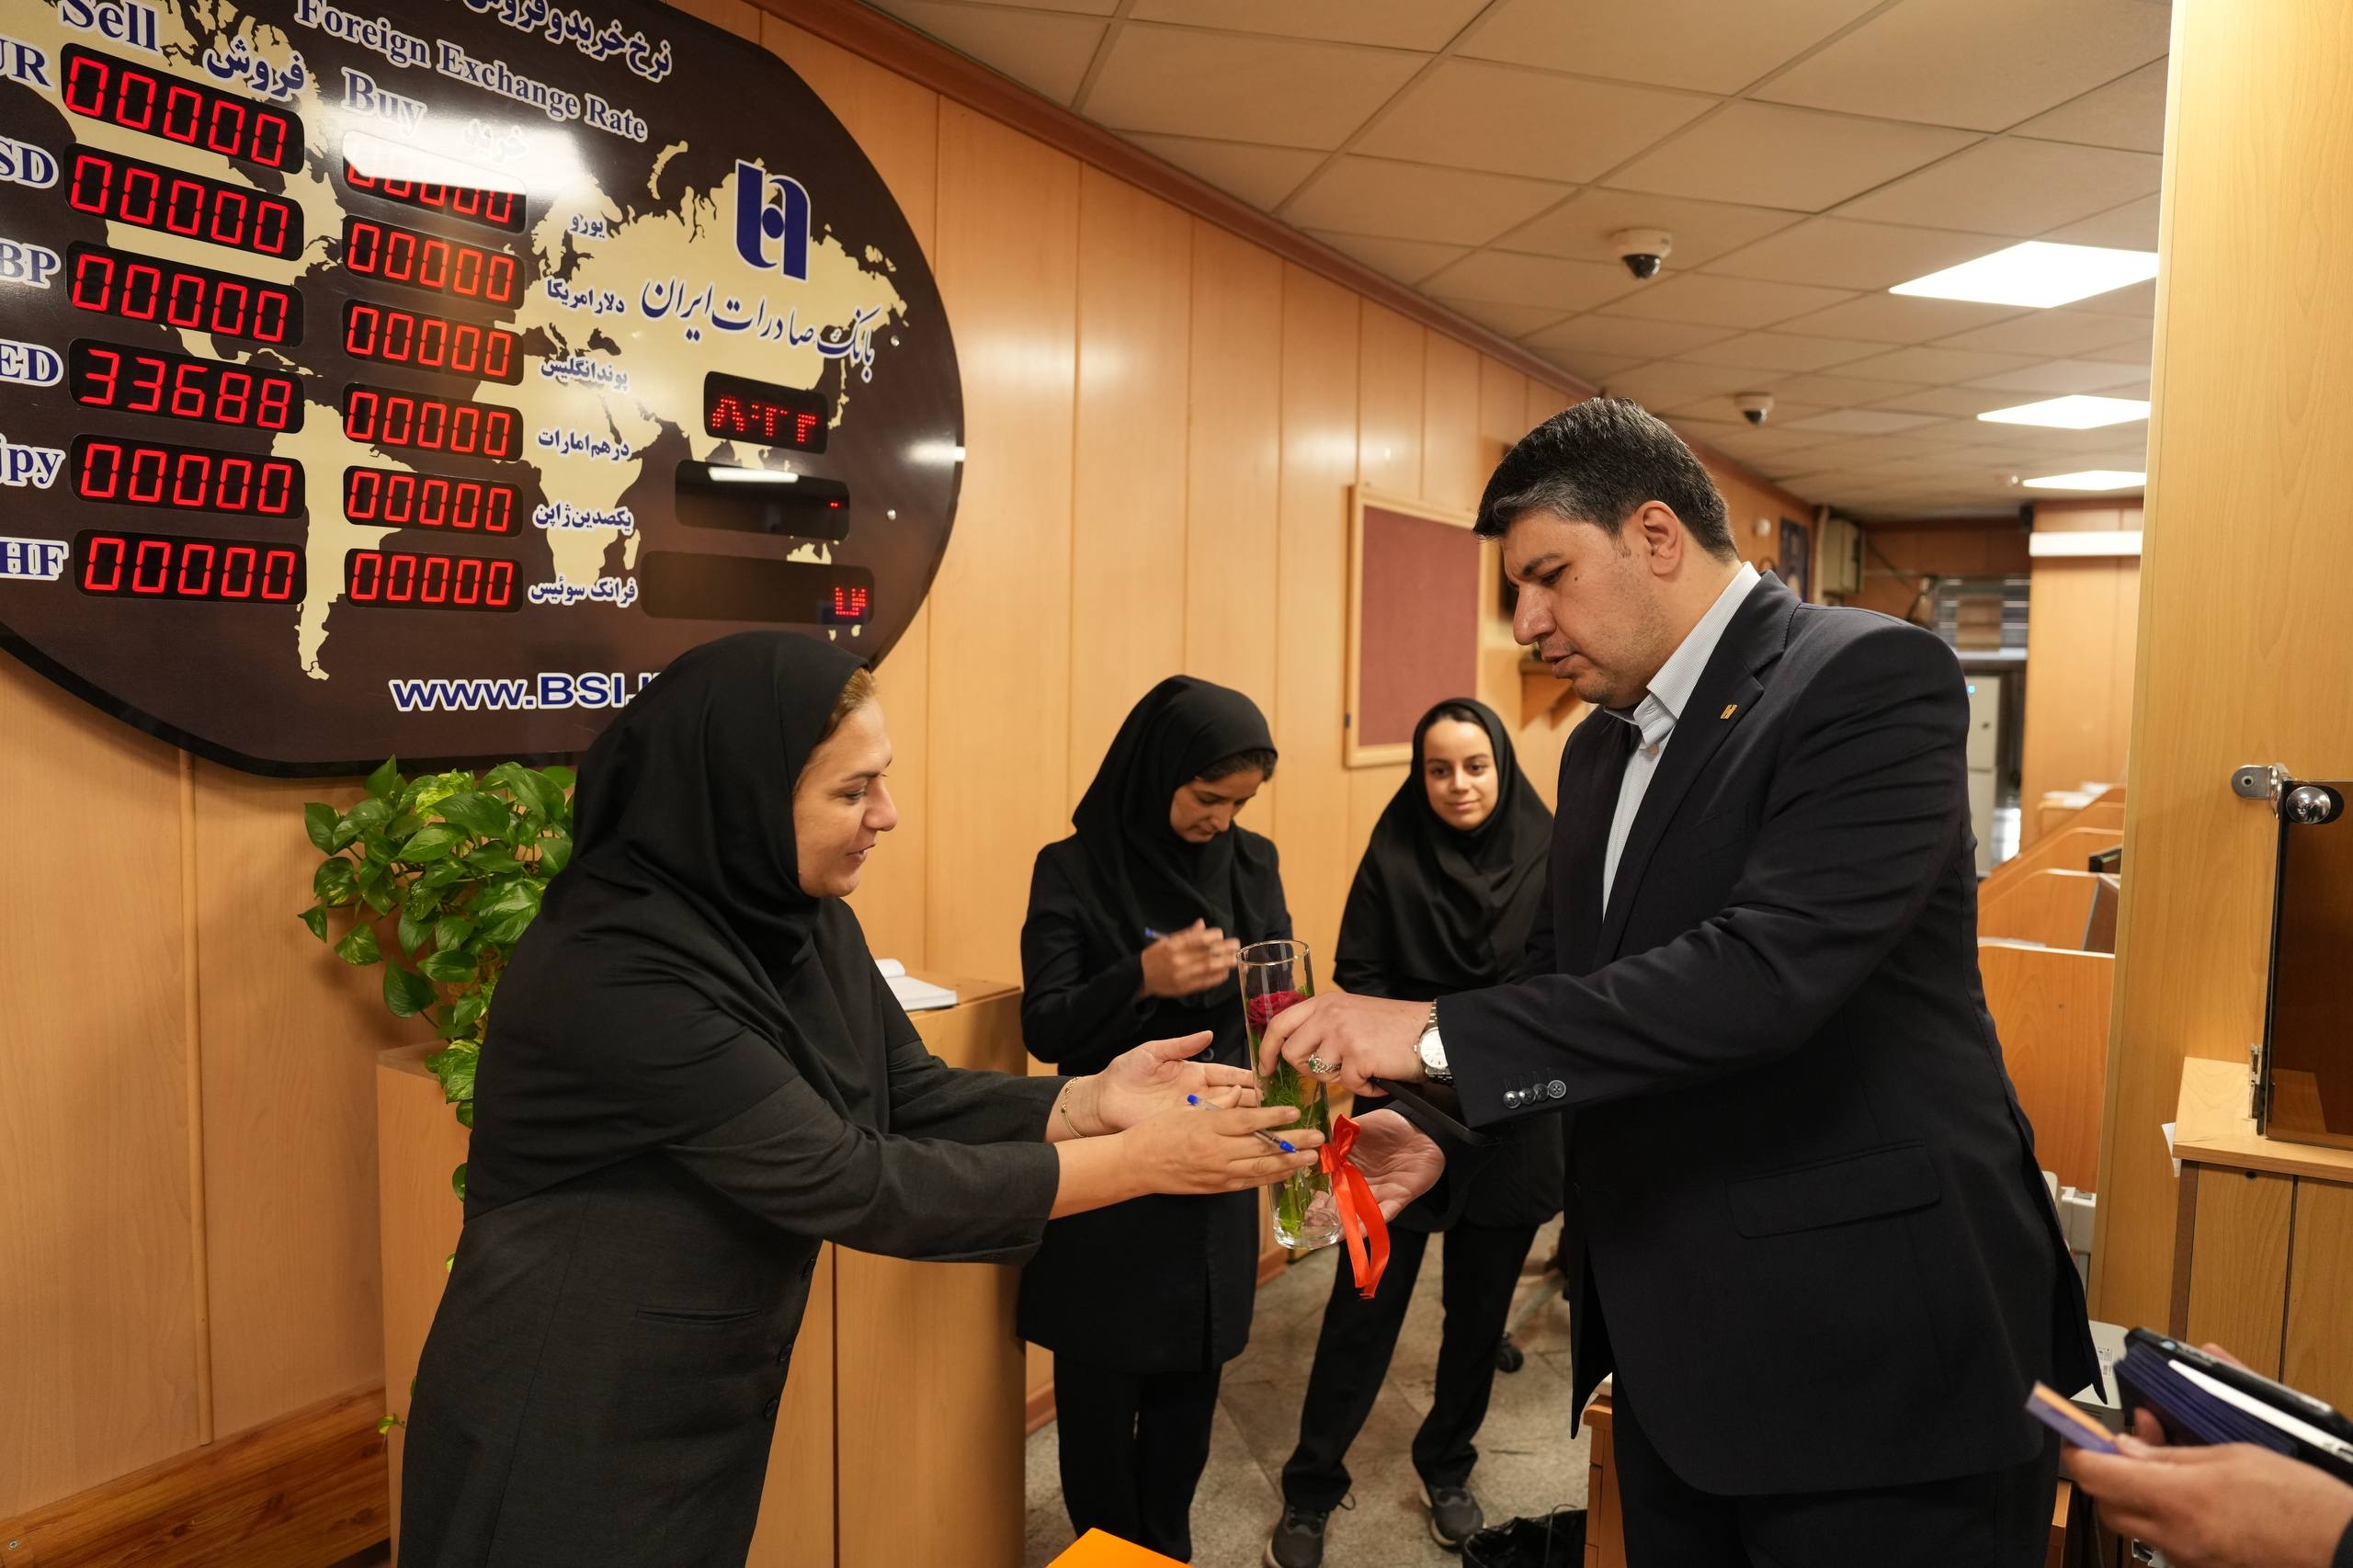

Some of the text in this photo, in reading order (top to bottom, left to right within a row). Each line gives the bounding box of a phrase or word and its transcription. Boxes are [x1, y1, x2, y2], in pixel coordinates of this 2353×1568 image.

[63, 0, 158, 51] Sell
[564, 14, 627, 58] خرید
[627, 33, 671, 80] نرخ
[207, 40, 304, 96] فروش
[299, 0, 645, 139] Foreign Exchange Rate
[65, 56, 288, 167] 00000
[347, 71, 425, 135] Buy
[71, 154, 289, 254] 00000
[571, 215, 606, 238] یورو
[347, 222, 515, 303] 00000
[73, 254, 289, 343] 00000
[641, 278, 881, 379] بانک صادرات ایران
[347, 306, 513, 378] 00000
[79, 348, 292, 429] 33688
[346, 391, 511, 457] 00000
[80, 442, 292, 514] 00000
[347, 471, 513, 532] 00000
[84, 537, 296, 600] 00000
[350, 552, 514, 606] 00000
[590, 580, 636, 604] فرانک
